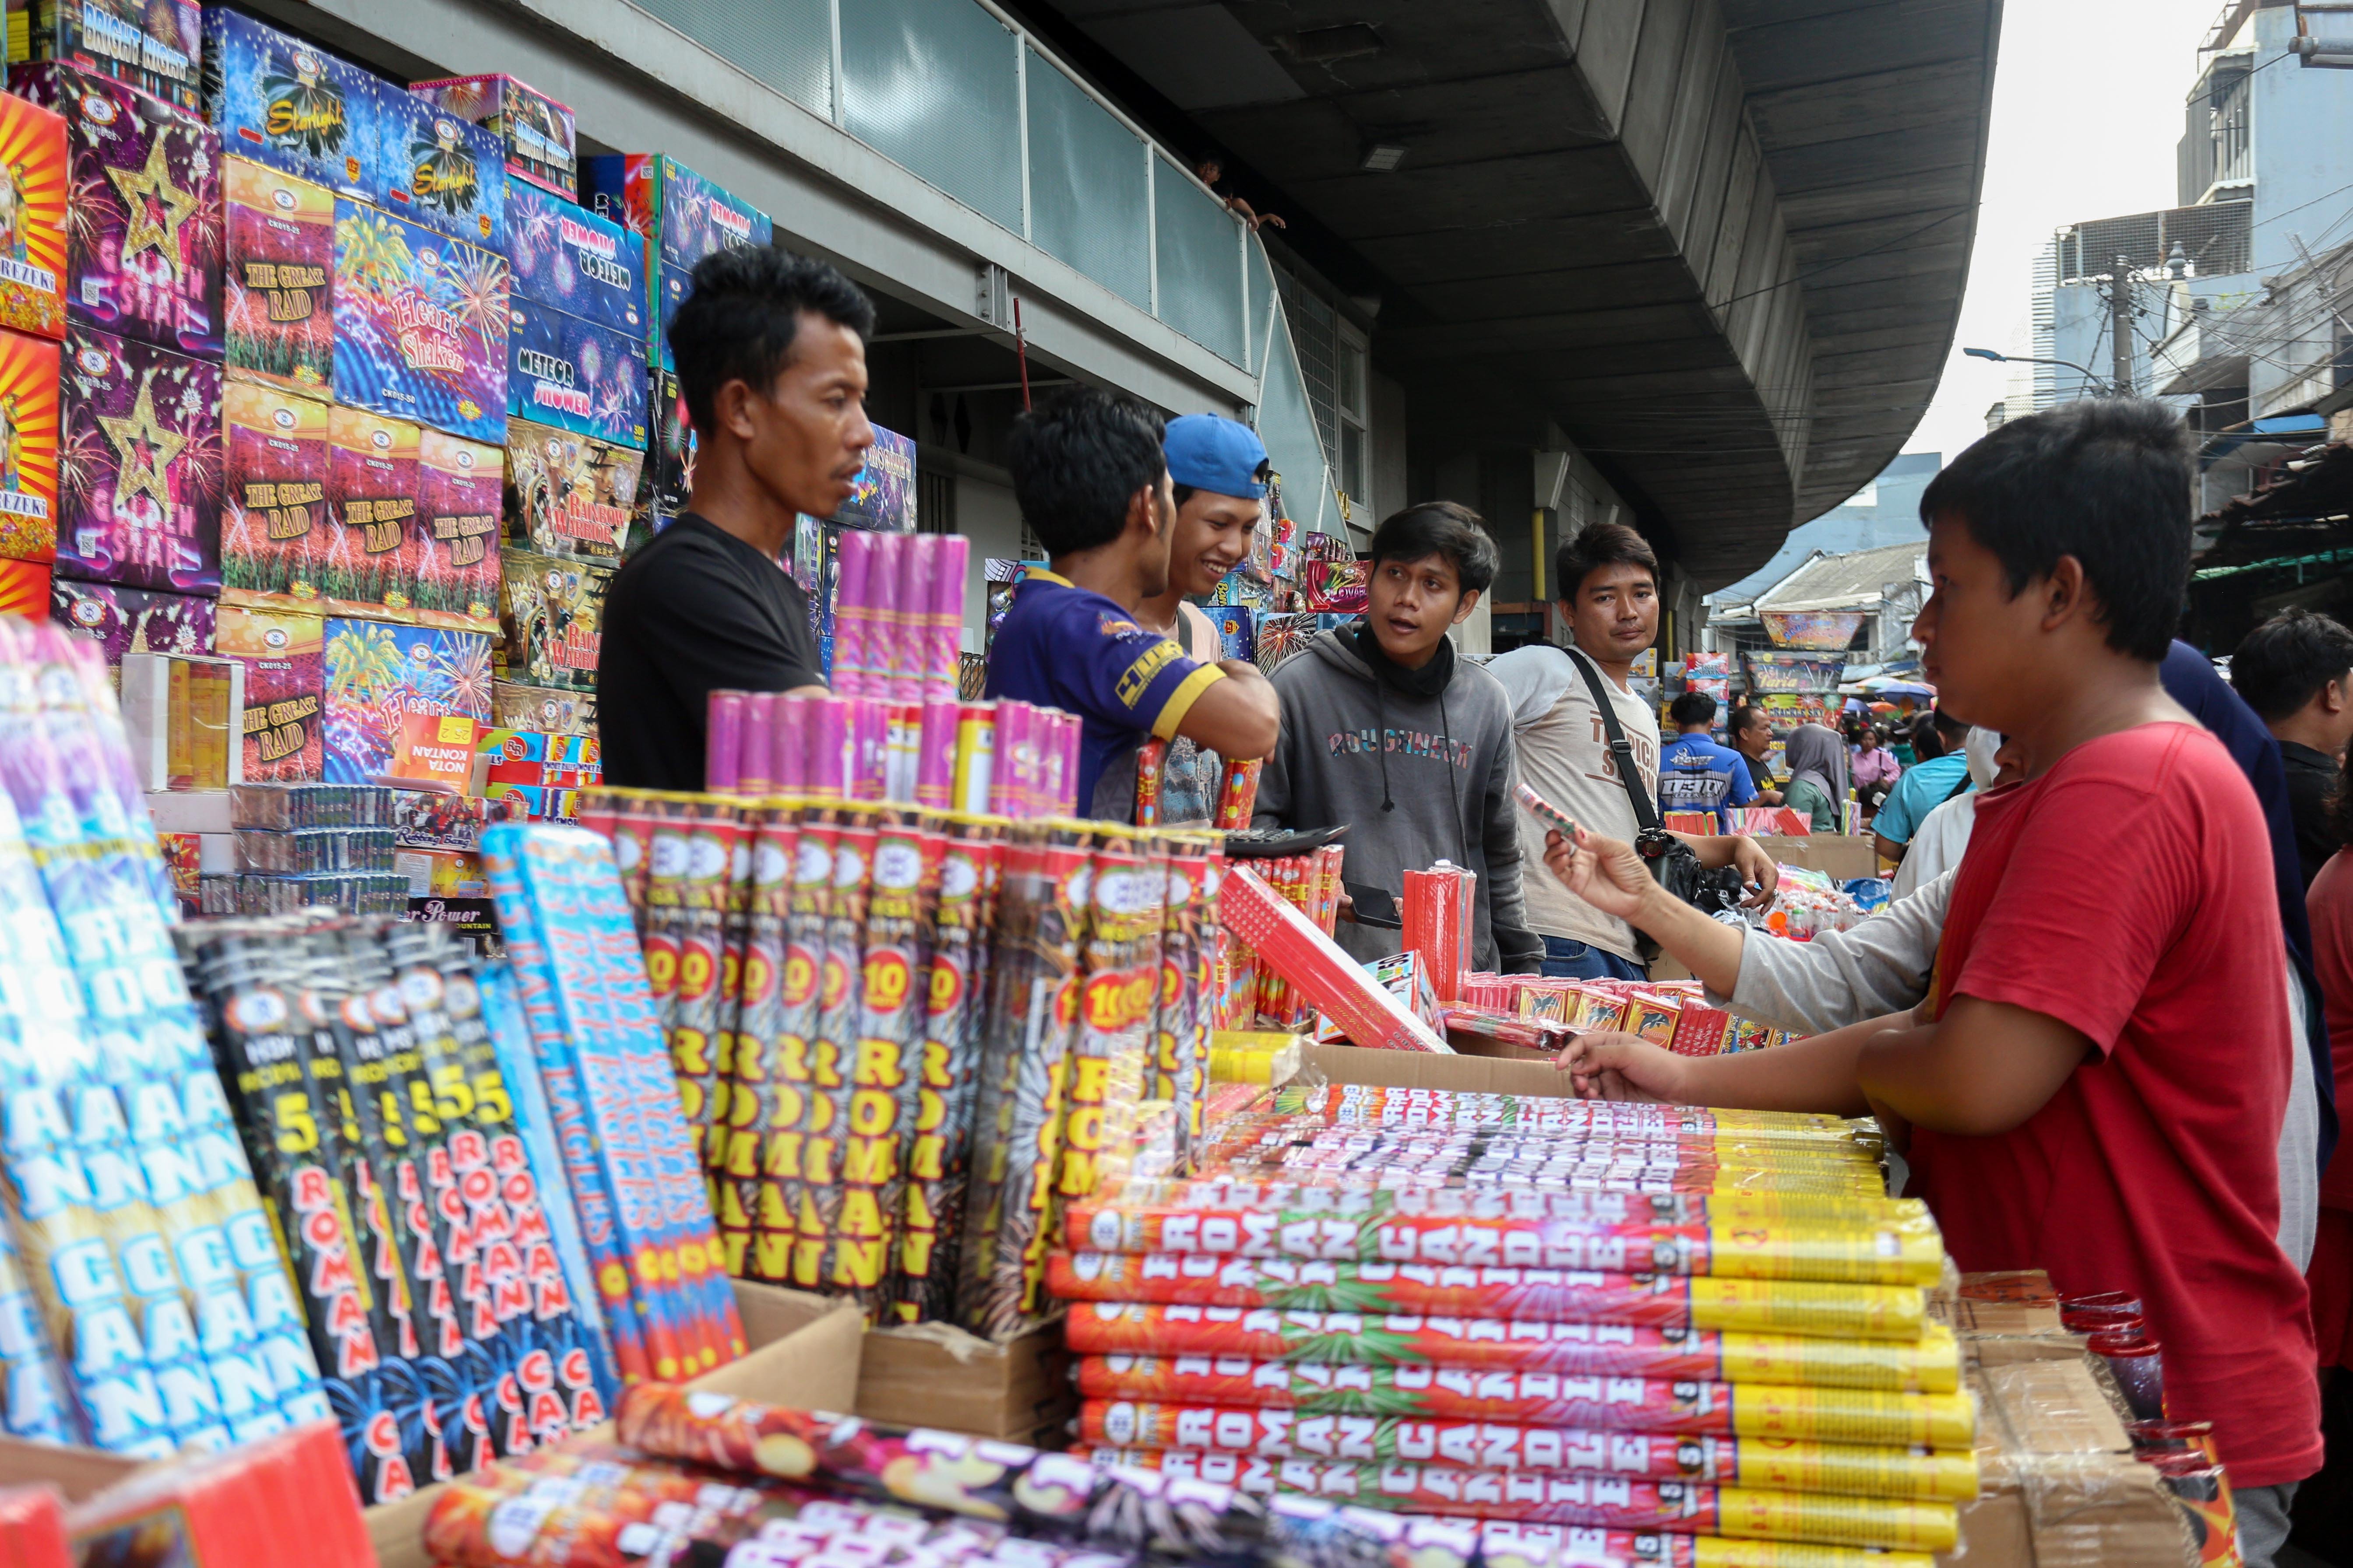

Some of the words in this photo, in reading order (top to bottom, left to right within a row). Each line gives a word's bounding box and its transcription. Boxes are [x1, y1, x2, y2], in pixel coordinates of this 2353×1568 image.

[82, 1, 142, 66] BRIGHT
[141, 32, 189, 82] NIGHT
[266, 98, 343, 137] Starlight
[515, 117, 546, 162] BRIGHT
[545, 134, 570, 172] NIGHT
[412, 162, 476, 196] Starlight
[268, 219, 301, 235] CK015-25
[560, 215, 616, 260] SHOWER
[245, 263, 278, 288] THE
[277, 264, 326, 288] GREAT
[578, 249, 631, 292] METEOR
[268, 289, 312, 321] RAID
[392, 289, 460, 338] Heart
[402, 330, 465, 374] Shaken
[518, 347, 575, 389] METEOR
[382, 388, 416, 404] CK015-50
[534, 380, 592, 419] SHOWER
[268, 439, 300, 452] CK015-25
[245, 484, 277, 508] THE
[277, 483, 323, 506] GREAT
[345, 500, 374, 524] THE
[373, 499, 415, 522] GREAT
[569, 491, 626, 528] RAINBOW
[268, 506, 310, 539] RAID
[366, 521, 402, 552] RAID
[434, 517, 458, 539] THE
[458, 515, 495, 537] GREAT
[553, 507, 613, 545] WARRIOR
[451, 535, 484, 566] RAID
[568, 621, 603, 653] RAIN
[259, 661, 292, 670] CK015-25
[268, 696, 319, 727] GREAT
[1769, 708, 1806, 717] CRACKLE
[1808, 708, 1824, 717] SKY
[260, 722, 305, 761] RAID
[412, 745, 468, 761] KONTAN
[506, 739, 524, 756] RR
[1328, 728, 1473, 770] ROUGHNECK
[1590, 717, 1658, 778] TPICAL
[428, 760, 466, 773] NOTA
[1602, 749, 1656, 801] SRM
[396, 826, 440, 845] Rubbing
[444, 833, 472, 848] Bang
[556, 817, 579, 826] SMOK
[421, 900, 481, 923] Power
[864, 963, 907, 997] 10
[1643, 1027, 1670, 1041] Dolphin
[432, 1064, 476, 1119] 5
[472, 1069, 513, 1125] 5
[273, 1092, 319, 1153] 5
[533, 1065, 616, 1247] EAGLES
[1161, 1212, 1359, 1261] ROMAN
[1378, 1225, 1626, 1271] CANDLE
[291, 1164, 380, 1378] ROMAN
[1176, 1408, 1376, 1458] ROMAN
[1397, 1421, 1649, 1474] CANDLE
